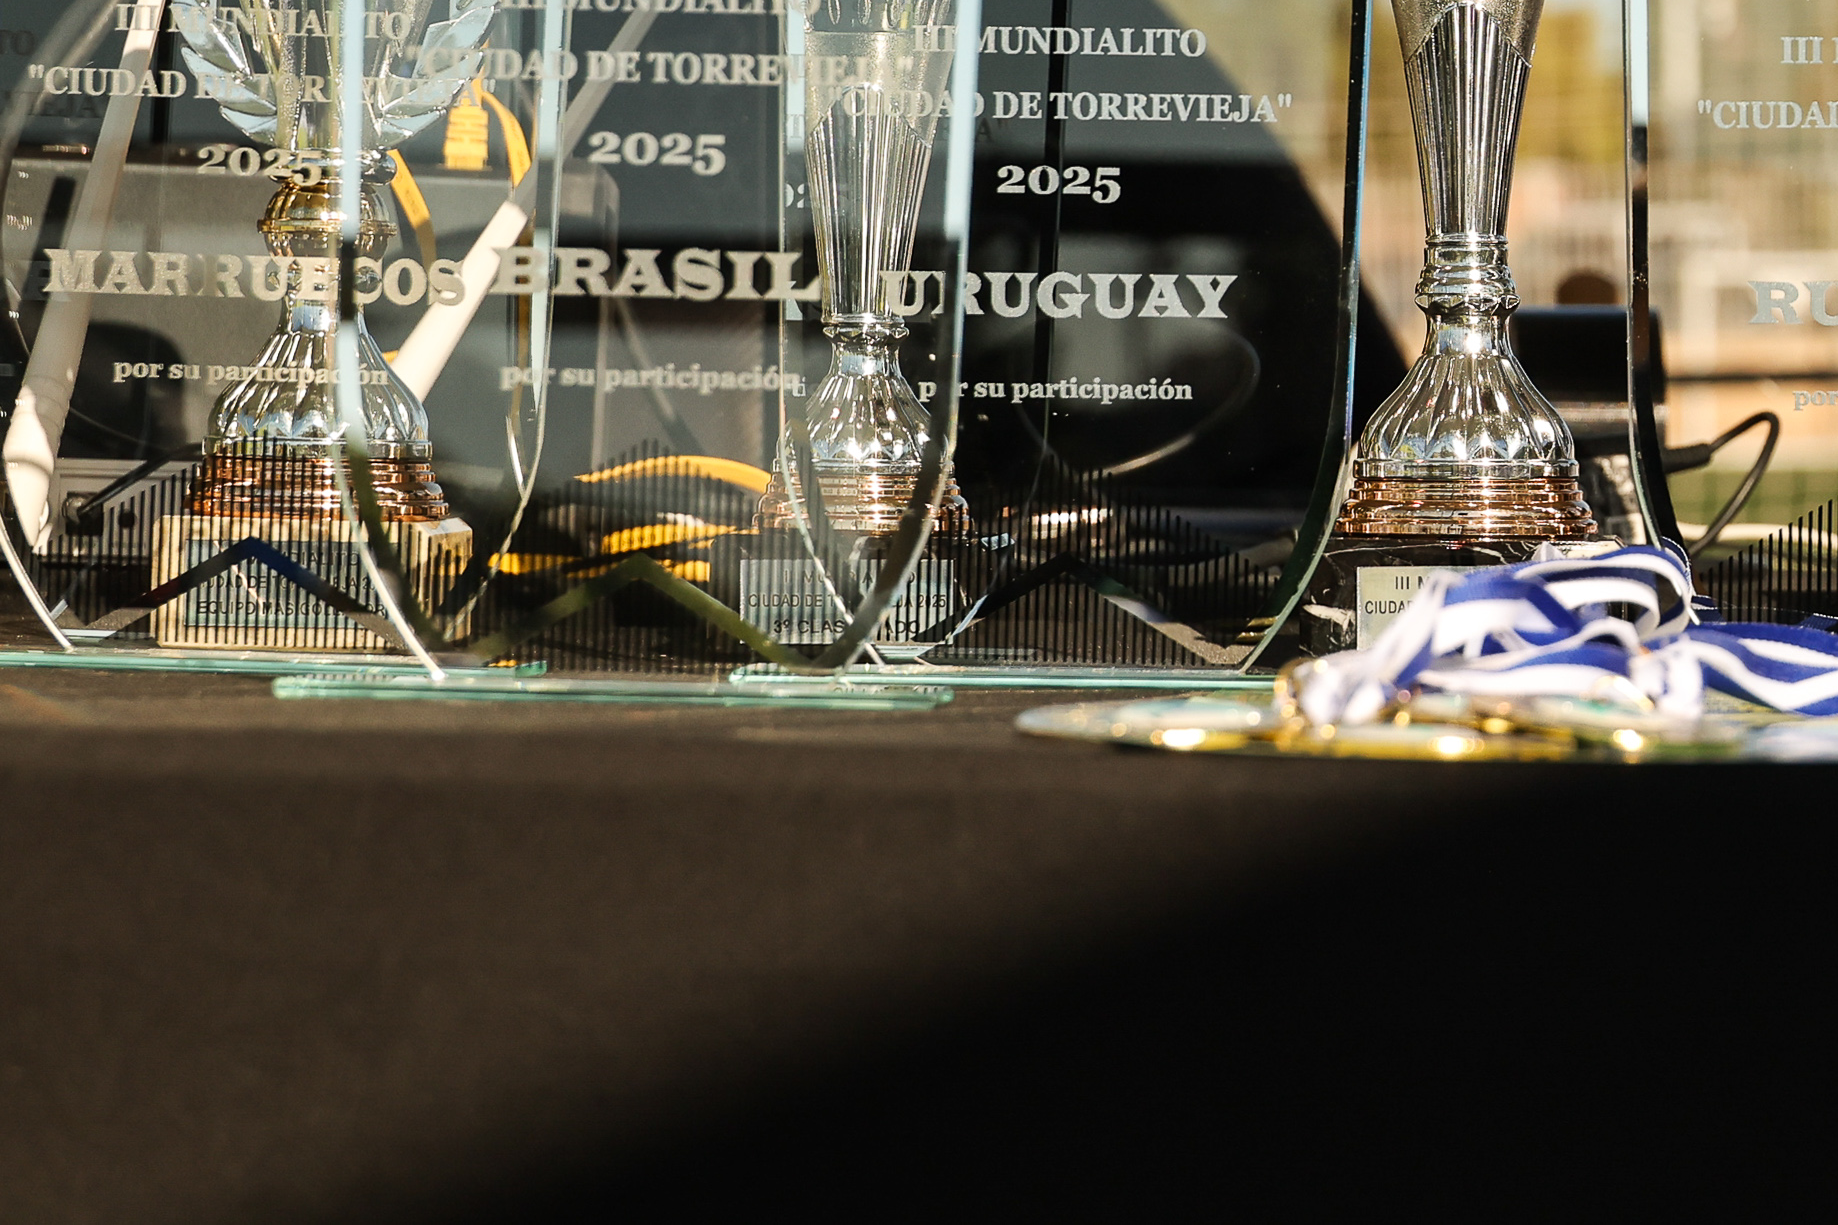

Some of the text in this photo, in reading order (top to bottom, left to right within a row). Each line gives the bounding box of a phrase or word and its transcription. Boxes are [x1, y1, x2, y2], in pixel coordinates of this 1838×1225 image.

[116, 3, 411, 41] III MUNDIALTO
[977, 26, 1206, 57] MUNDIALITO
[1780, 36, 1822, 65] III
[586, 51, 640, 83] DE
[28, 65, 187, 98] "CIUDAD
[254, 73, 495, 108] TOREVIEJA"
[993, 91, 1043, 119] DE
[1049, 91, 1292, 124] TORREVIEJA"
[197, 145, 324, 187] 2025
[588, 132, 726, 175] 2025
[996, 165, 1121, 204] 2025
[43, 248, 467, 307] MARRUECOS
[489, 246, 822, 301] BRASIL
[880, 270, 1239, 319] URUGUAY
[113, 360, 389, 387] por su participacón
[500, 362, 800, 395] por su participación
[918, 376, 1193, 405] pr su participación
[197, 575, 243, 590] UDAD
[250, 575, 267, 590] DE
[1395, 576, 1410, 590] III
[749, 594, 800, 608] CIUDAD
[805, 594, 823, 608] DE
[1365, 600, 1411, 615] CIUDA
[798, 619, 920, 635] CLASADO
